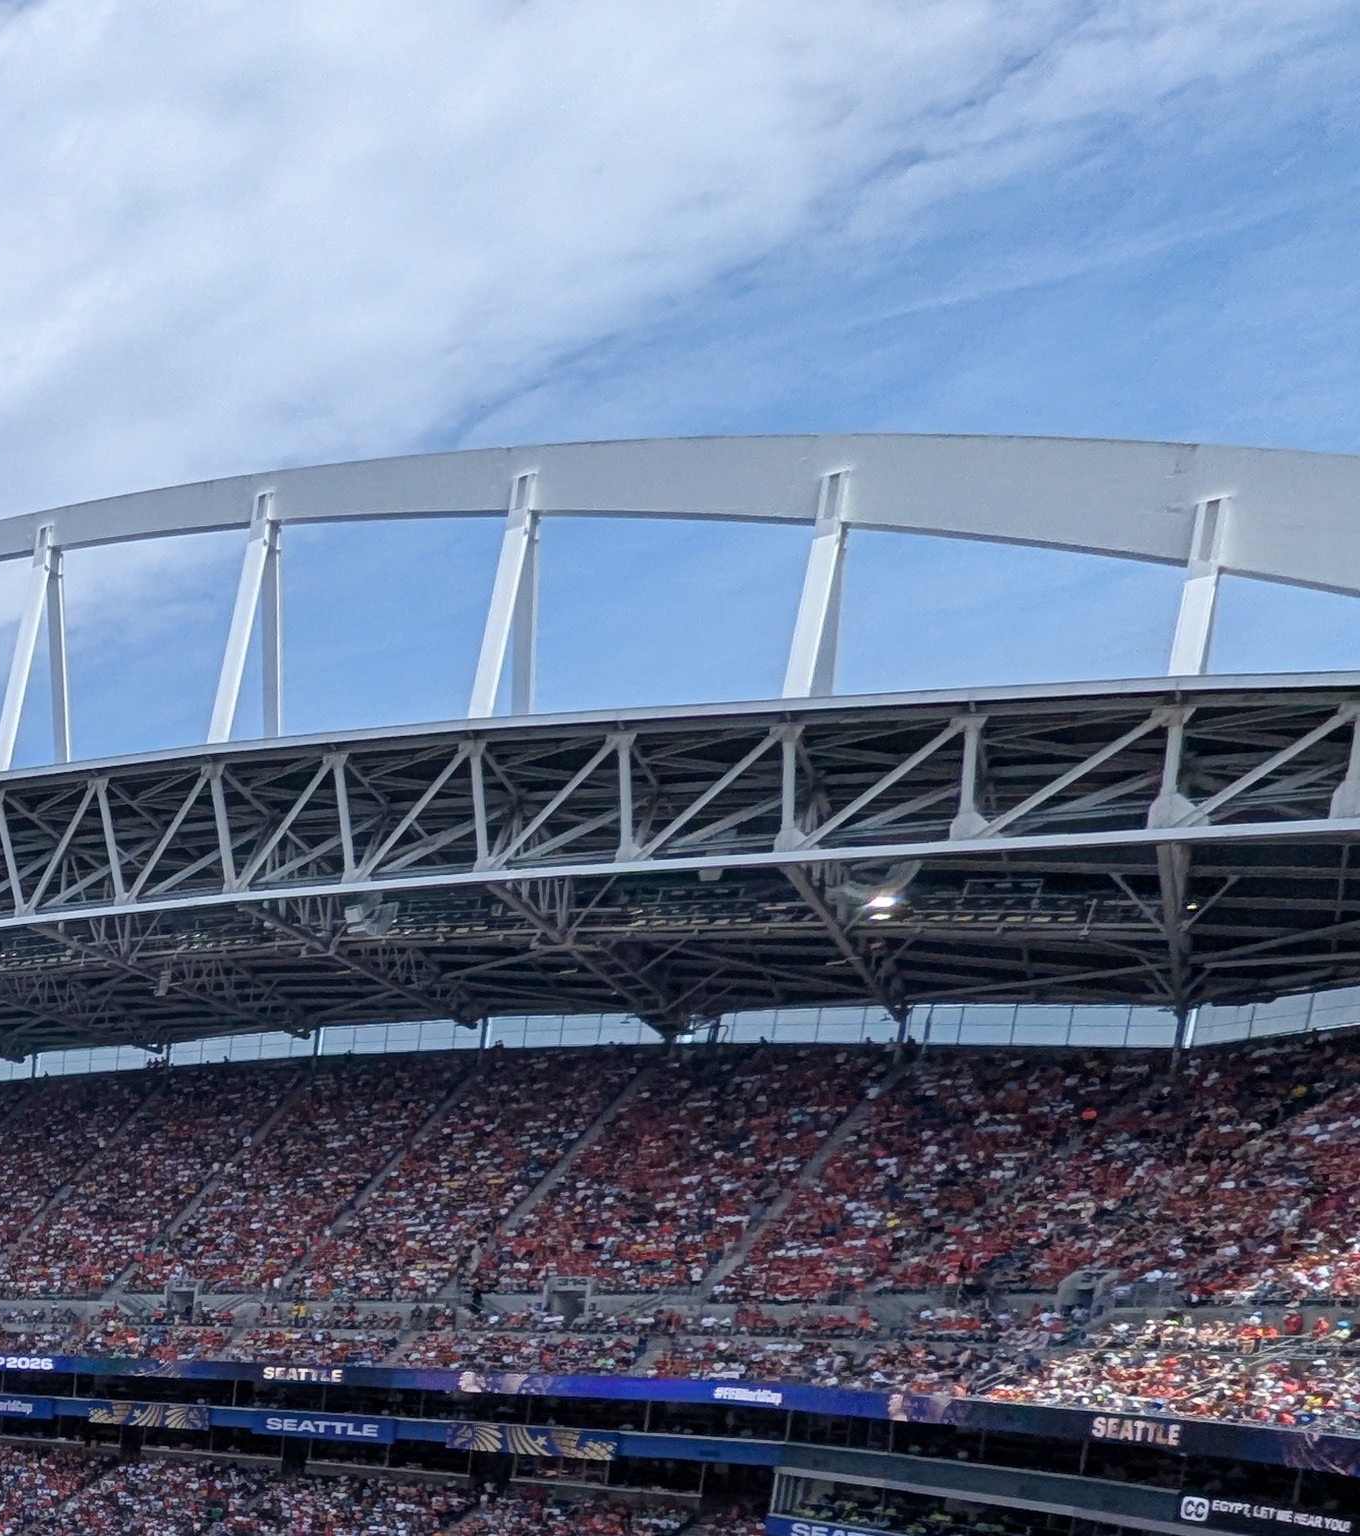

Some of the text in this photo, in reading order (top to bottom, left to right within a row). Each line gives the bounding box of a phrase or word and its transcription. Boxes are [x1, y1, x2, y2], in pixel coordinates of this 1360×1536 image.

[6, 1357, 54, 1370] 2026
[262, 1366, 344, 1382] SEATTLE
[265, 1417, 379, 1437] SEATTLE
[1091, 1416, 1181, 1446] SEATTLE
